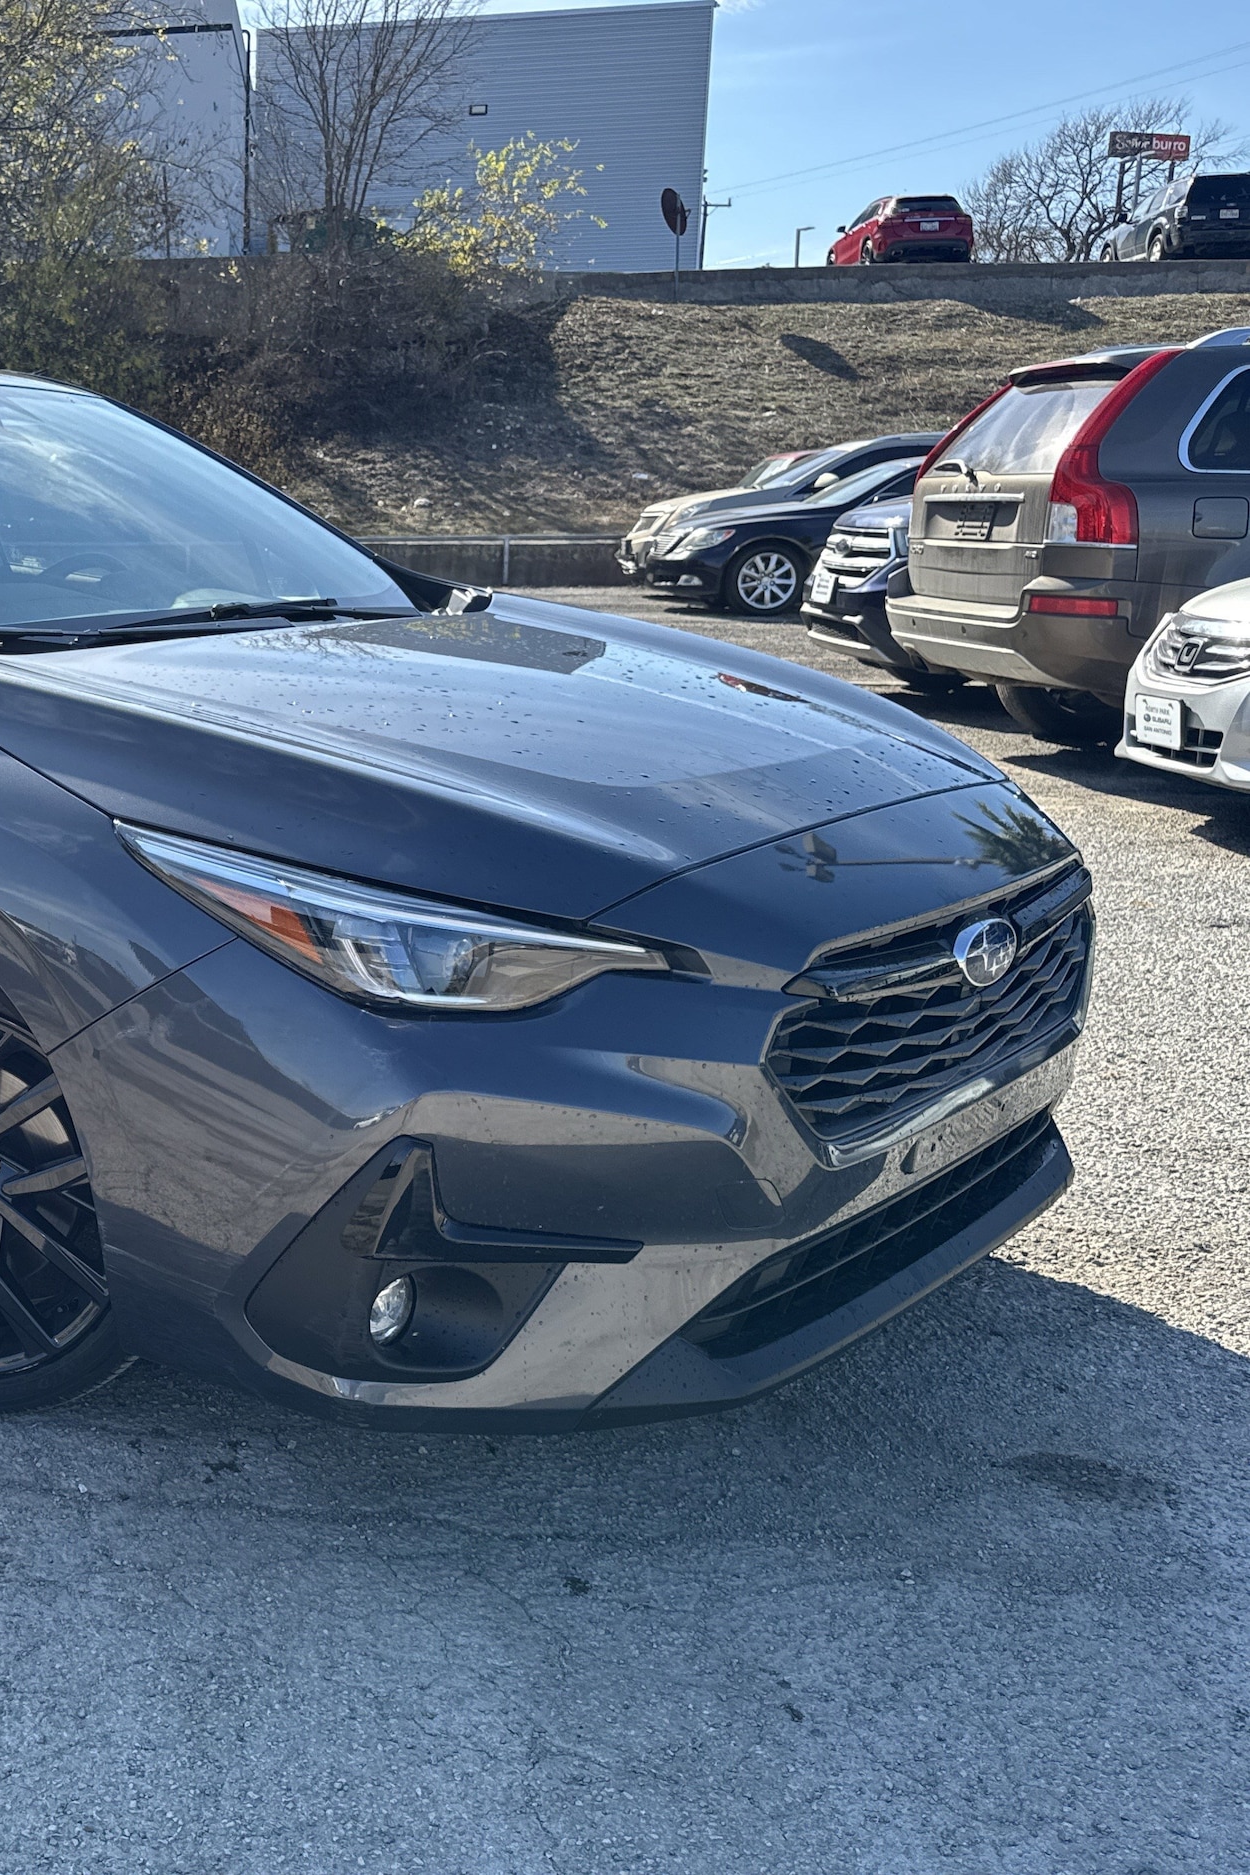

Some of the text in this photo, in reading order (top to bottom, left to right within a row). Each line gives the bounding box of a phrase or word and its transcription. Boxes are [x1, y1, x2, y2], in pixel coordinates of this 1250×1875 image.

[1152, 136, 1186, 151] burro
[1152, 716, 1172, 725] SUBARU
[1153, 727, 1172, 736] ANTONIO
